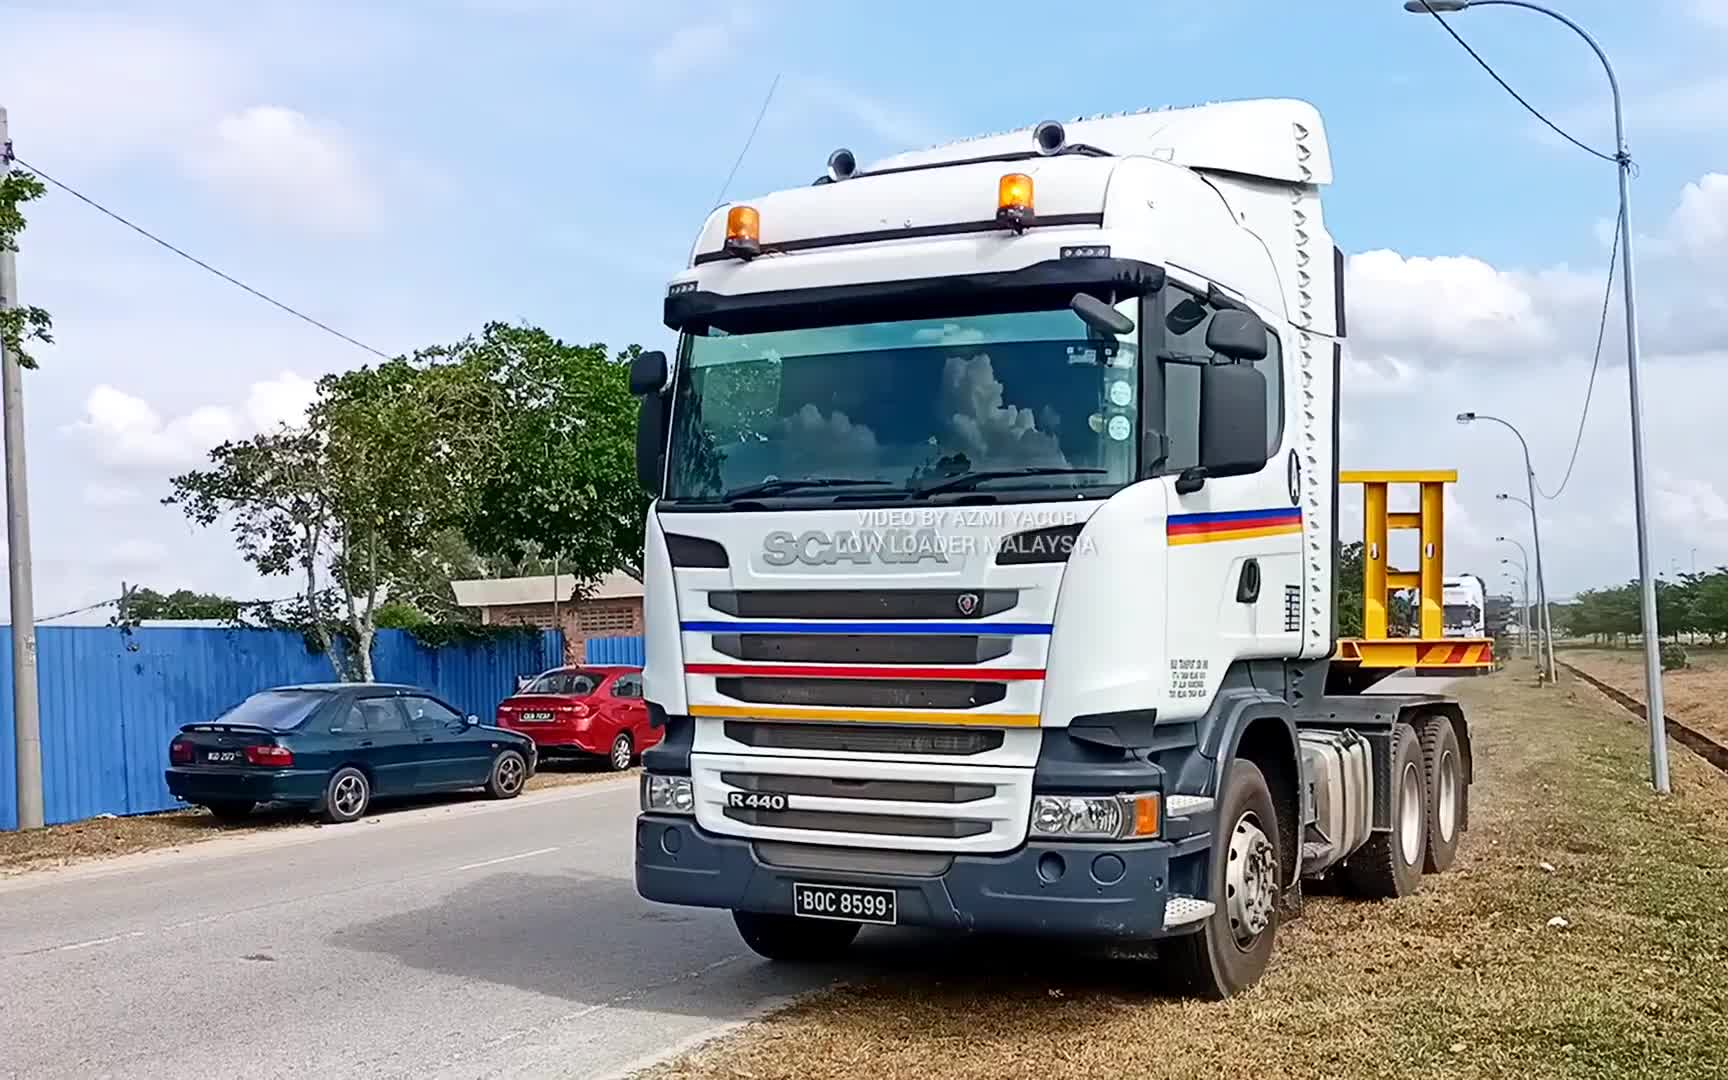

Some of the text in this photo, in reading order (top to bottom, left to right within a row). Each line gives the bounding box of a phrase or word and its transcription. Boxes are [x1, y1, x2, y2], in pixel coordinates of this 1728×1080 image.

[763, 529, 948, 566] SCANIA
[803, 890, 886, 916] BQC 8599
